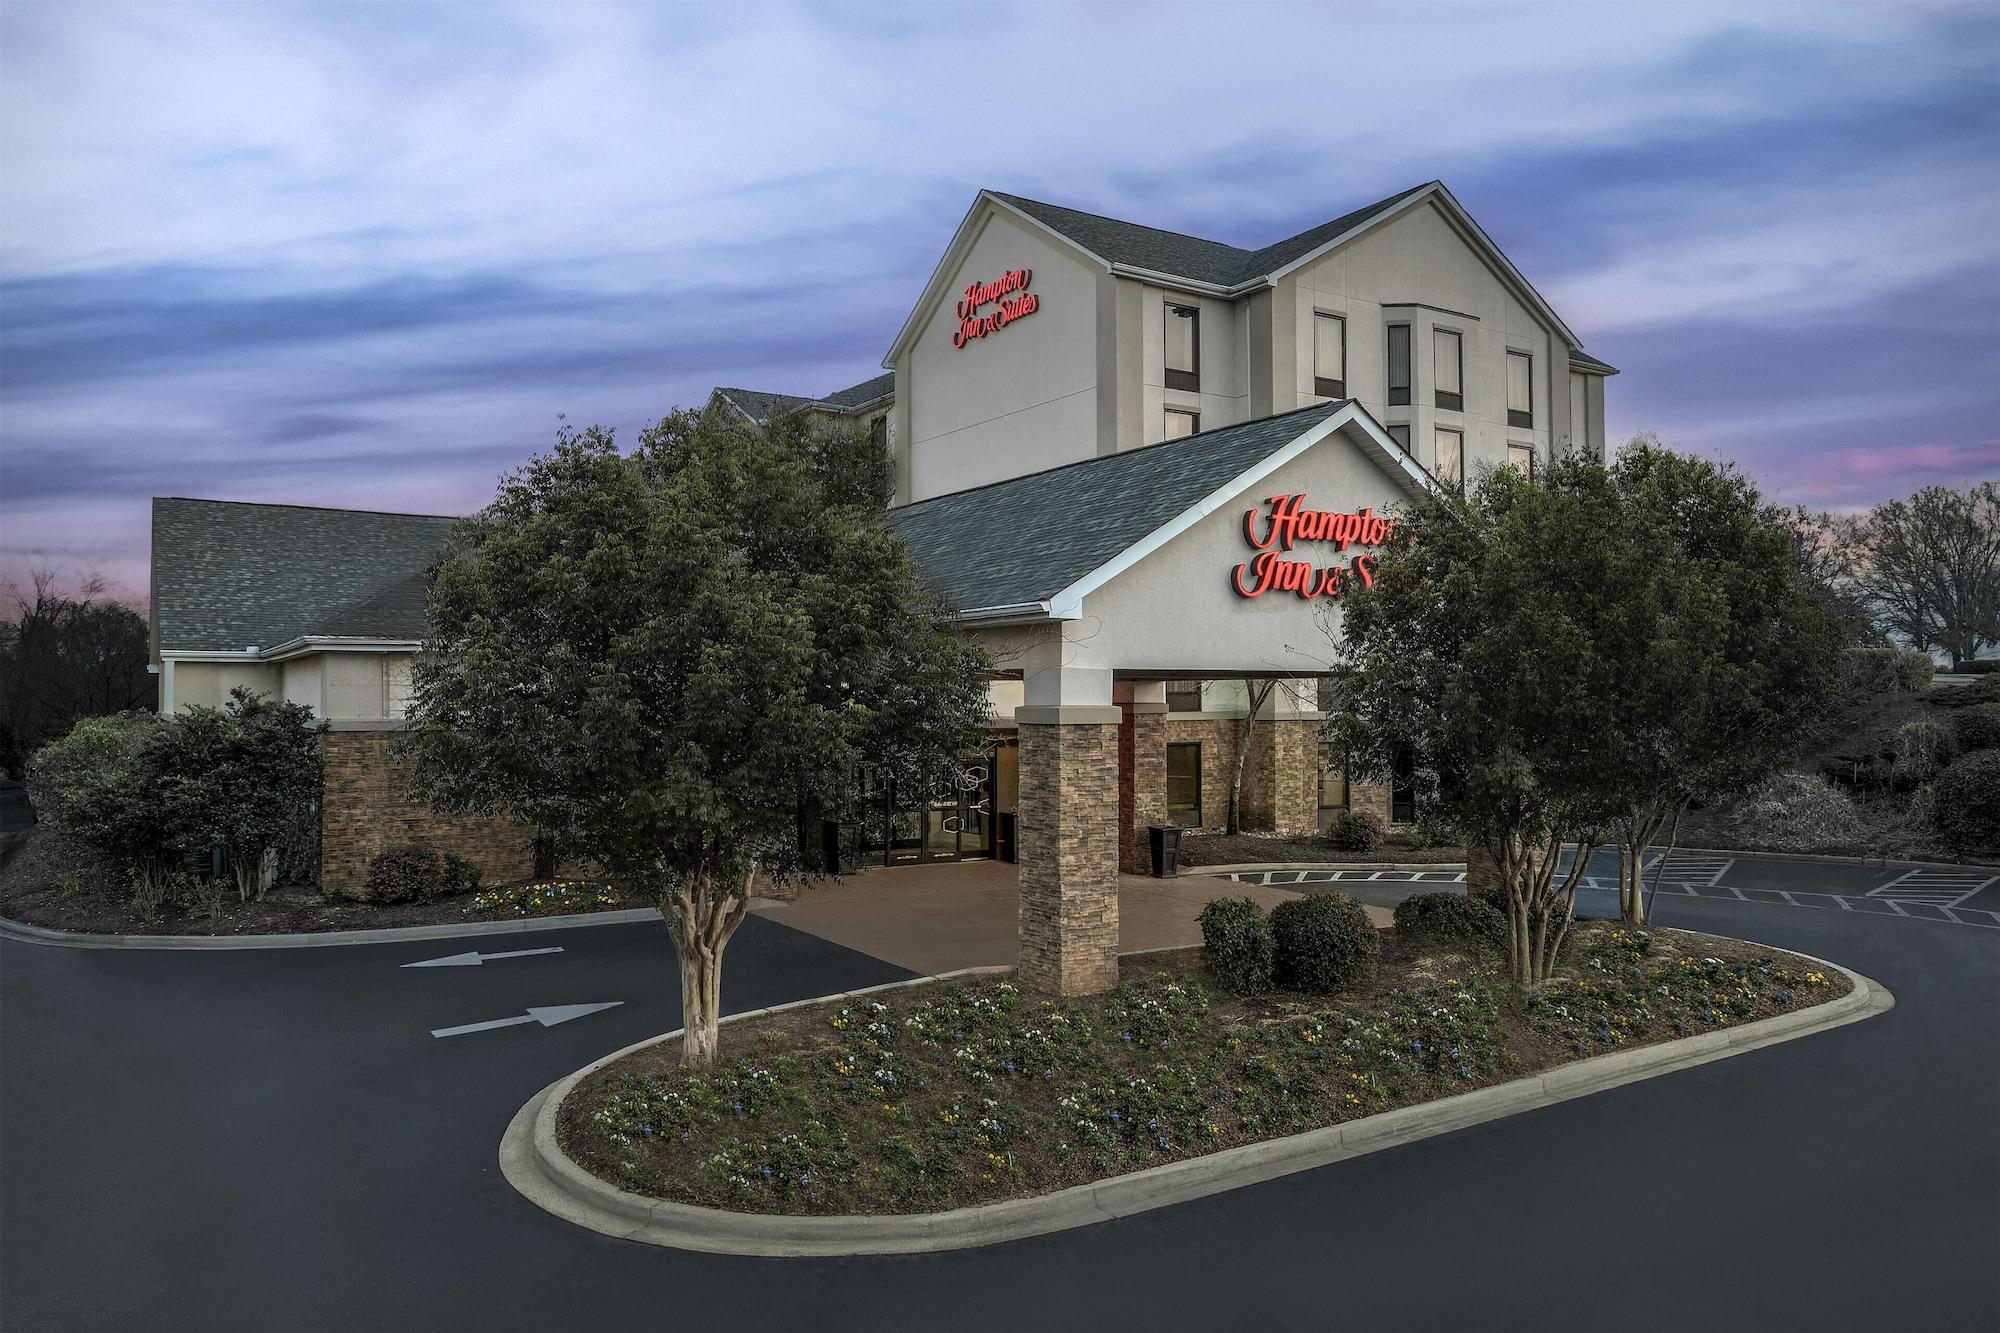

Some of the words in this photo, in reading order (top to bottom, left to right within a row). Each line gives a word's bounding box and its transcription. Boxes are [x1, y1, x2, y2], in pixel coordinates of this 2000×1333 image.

[957, 268, 1032, 320] Hampton
[953, 317, 988, 348] Inn
[986, 313, 1000, 332] &
[996, 293, 1040, 327] Suites
[1231, 550, 1327, 599] Inn
